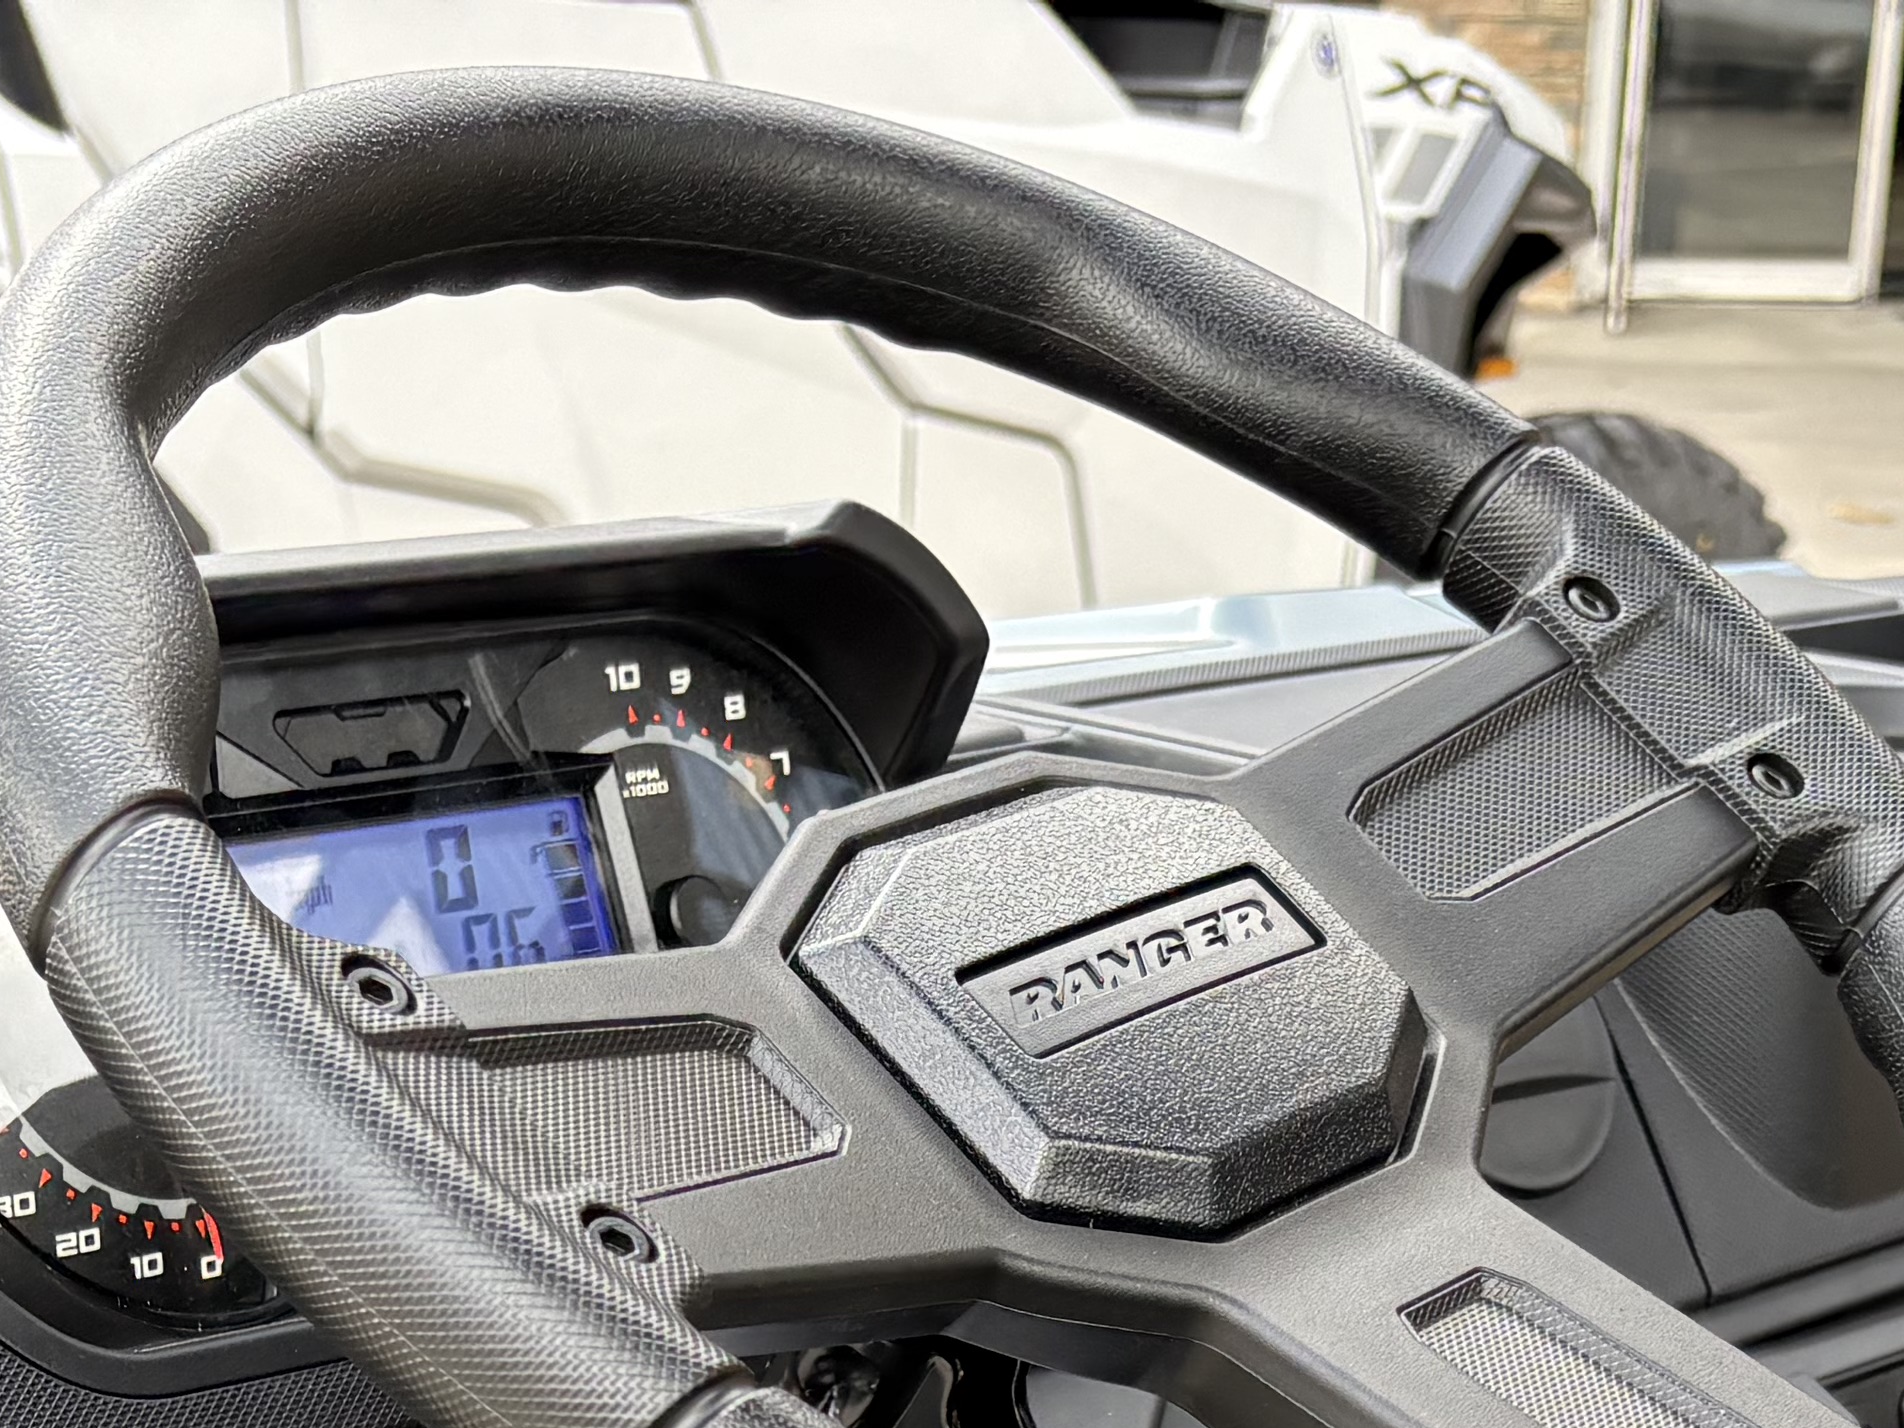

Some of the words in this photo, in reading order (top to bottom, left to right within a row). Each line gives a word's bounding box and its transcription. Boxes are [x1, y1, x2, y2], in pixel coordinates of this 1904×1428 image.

[1372, 56, 1493, 110] XP
[604, 663, 641, 691] 10
[669, 667, 691, 695] 9
[723, 692, 746, 721] 8
[625, 767, 660, 785] RPM
[770, 749, 790, 776] 7
[426, 824, 479, 914] 0
[1009, 898, 1274, 1028] RANGER
[55, 1227, 102, 1258] 20
[130, 1252, 164, 1280] 10
[200, 1254, 223, 1280] 0
